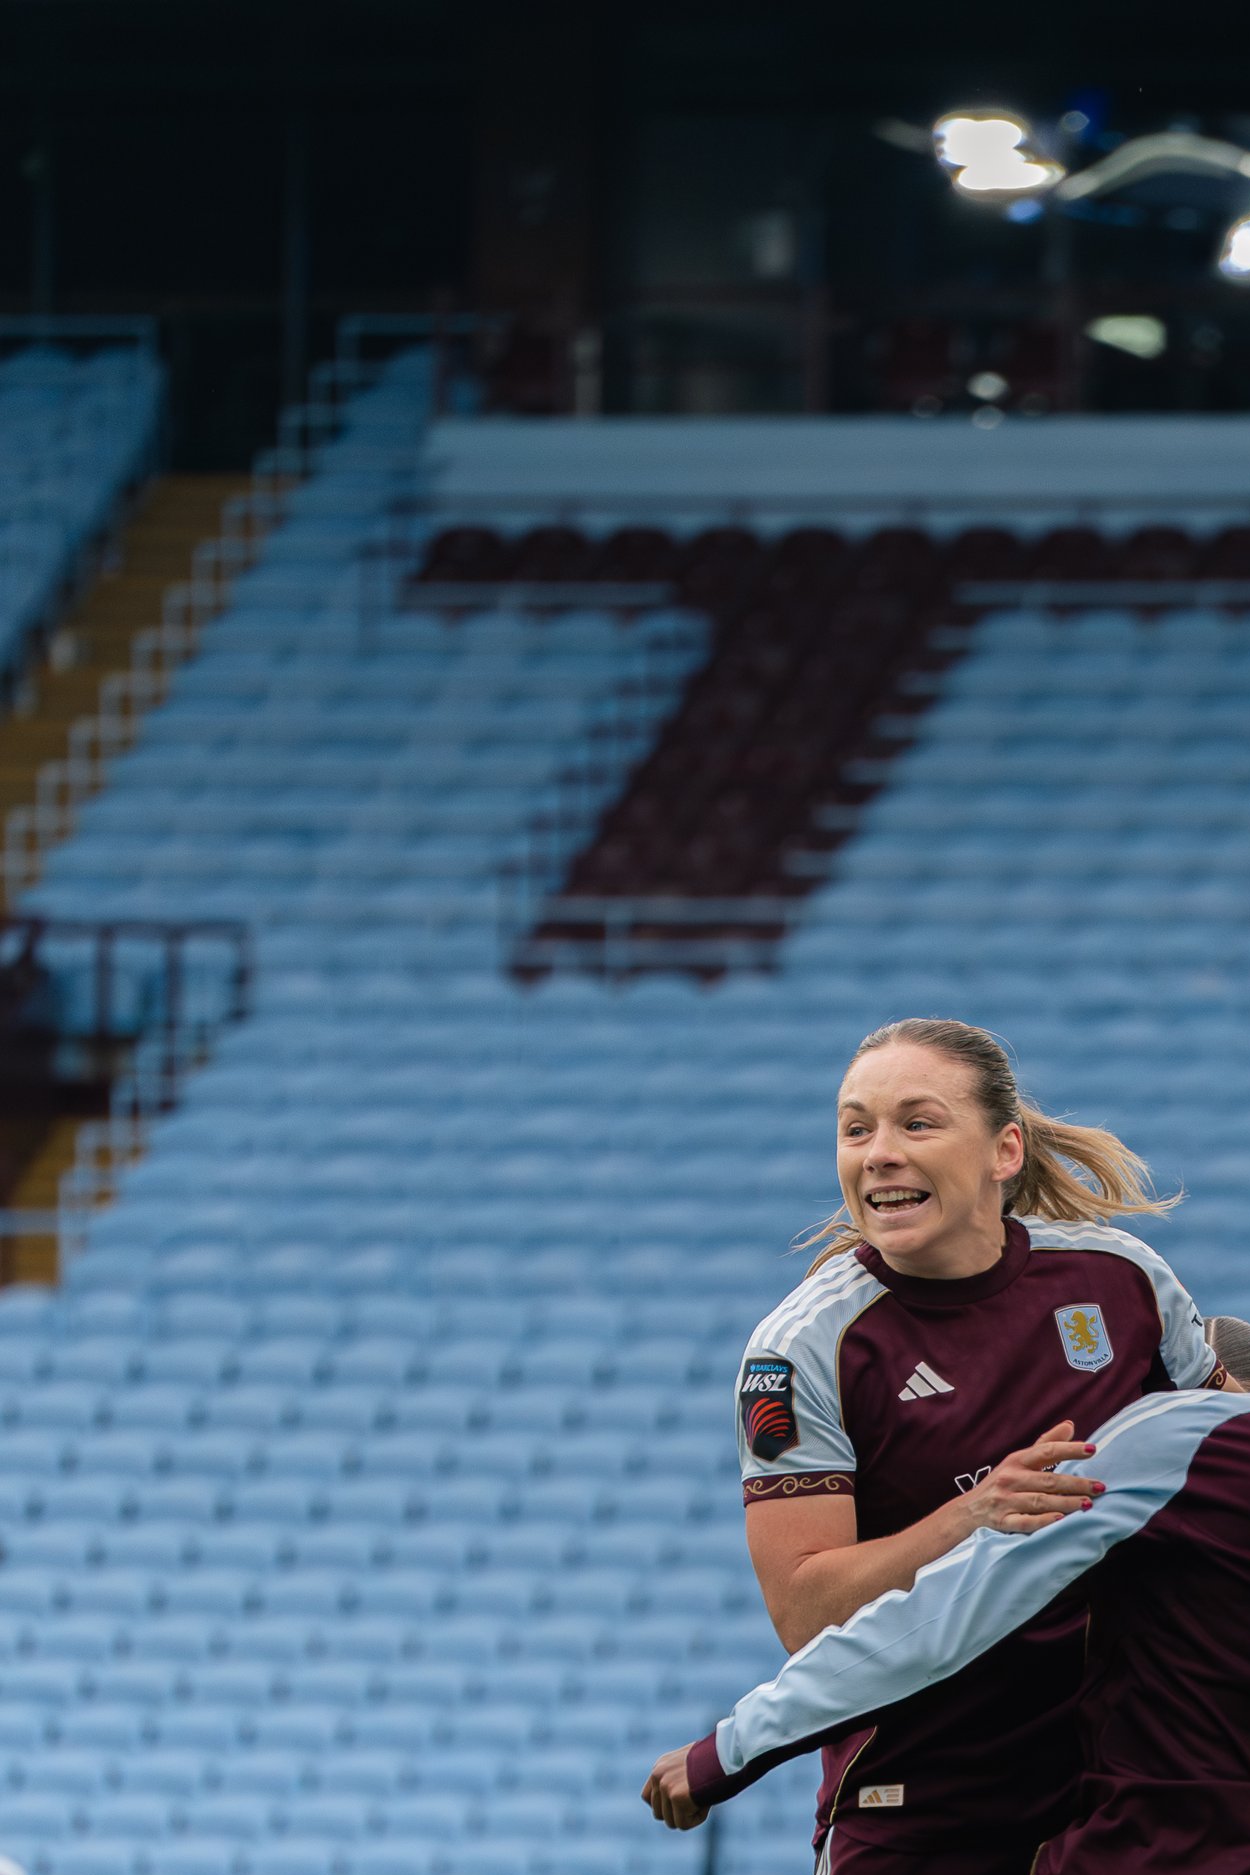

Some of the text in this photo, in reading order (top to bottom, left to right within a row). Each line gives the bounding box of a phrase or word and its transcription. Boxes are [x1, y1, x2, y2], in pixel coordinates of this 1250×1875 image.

[1073, 1353, 1109, 1366] ASTON VILLA
[741, 1373, 788, 1393] WSL
